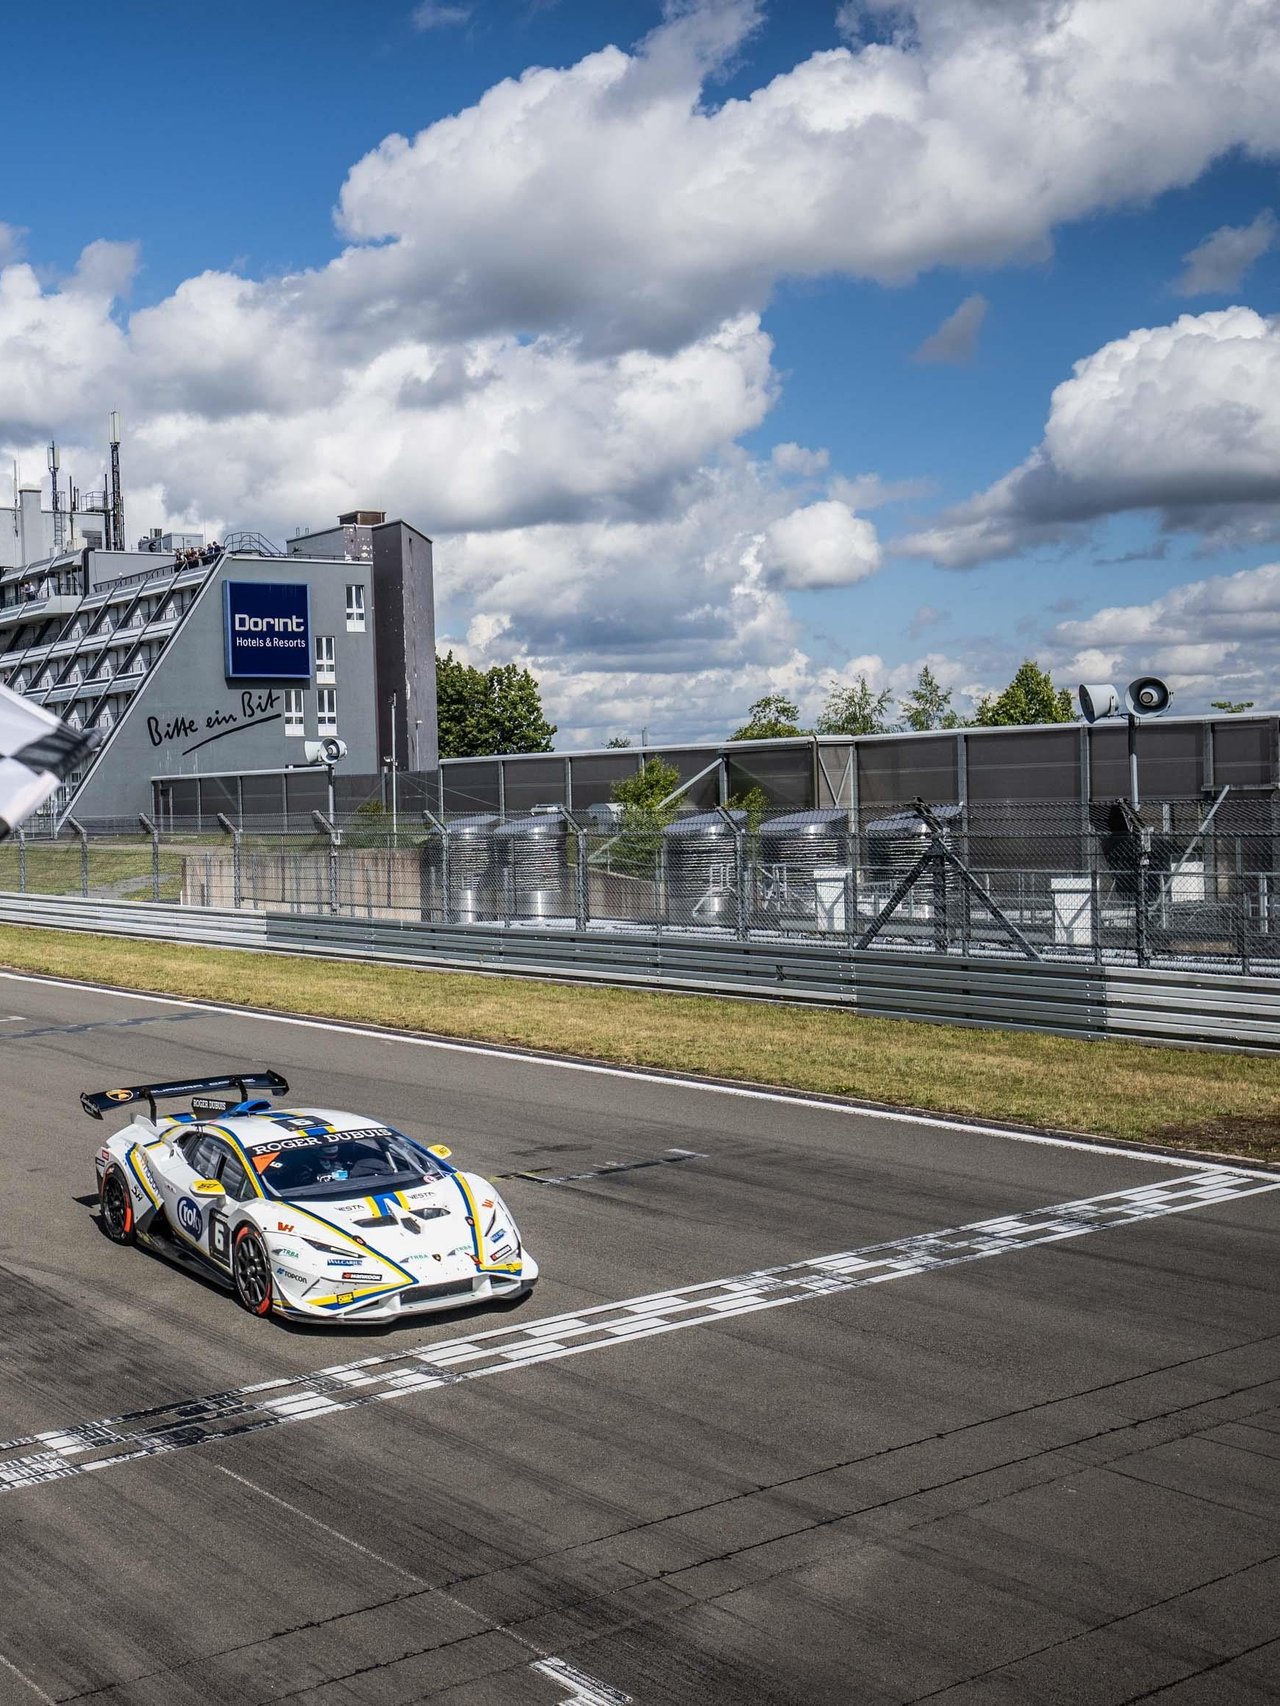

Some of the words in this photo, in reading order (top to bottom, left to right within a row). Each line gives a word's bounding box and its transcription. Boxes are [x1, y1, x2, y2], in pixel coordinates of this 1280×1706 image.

[235, 614, 305, 632] Dorint
[236, 637, 264, 647] Hotels
[265, 637, 272, 647] &
[273, 637, 306, 648] Resorts
[147, 716, 198, 746] Bitte
[206, 710, 237, 728] ein
[242, 690, 281, 717] Bit
[193, 1099, 208, 1108] ROGER
[252, 1136, 322, 1155] ROGER
[324, 1127, 392, 1145] DUBUIS
[215, 1221, 225, 1251] 6
